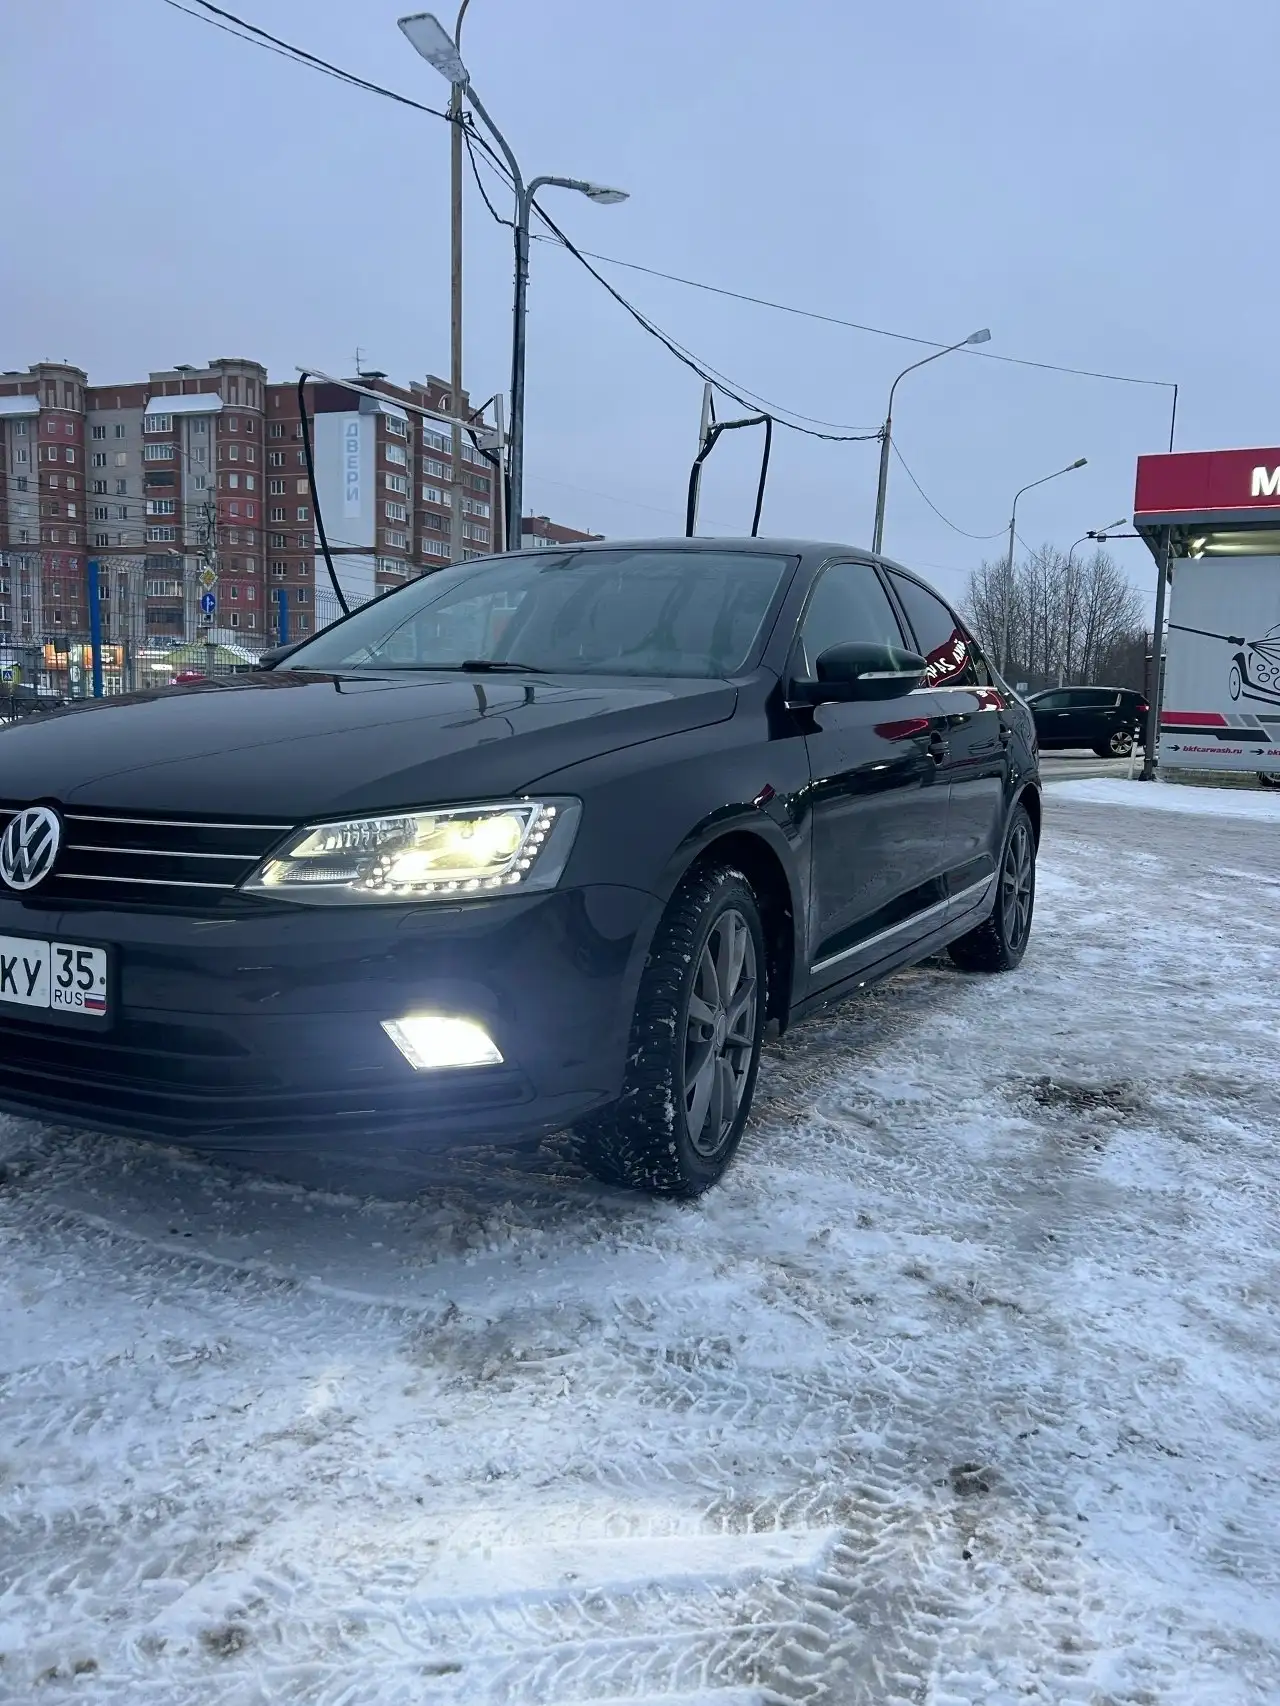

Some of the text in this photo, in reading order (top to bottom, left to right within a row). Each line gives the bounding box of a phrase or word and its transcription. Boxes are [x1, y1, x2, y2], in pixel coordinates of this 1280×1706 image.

[345, 422, 359, 501] ДВЕРИ
[1182, 745, 1243, 755] bkfcarwash.ru
[56, 948, 94, 990] 35
[54, 989, 83, 1006] RUS
